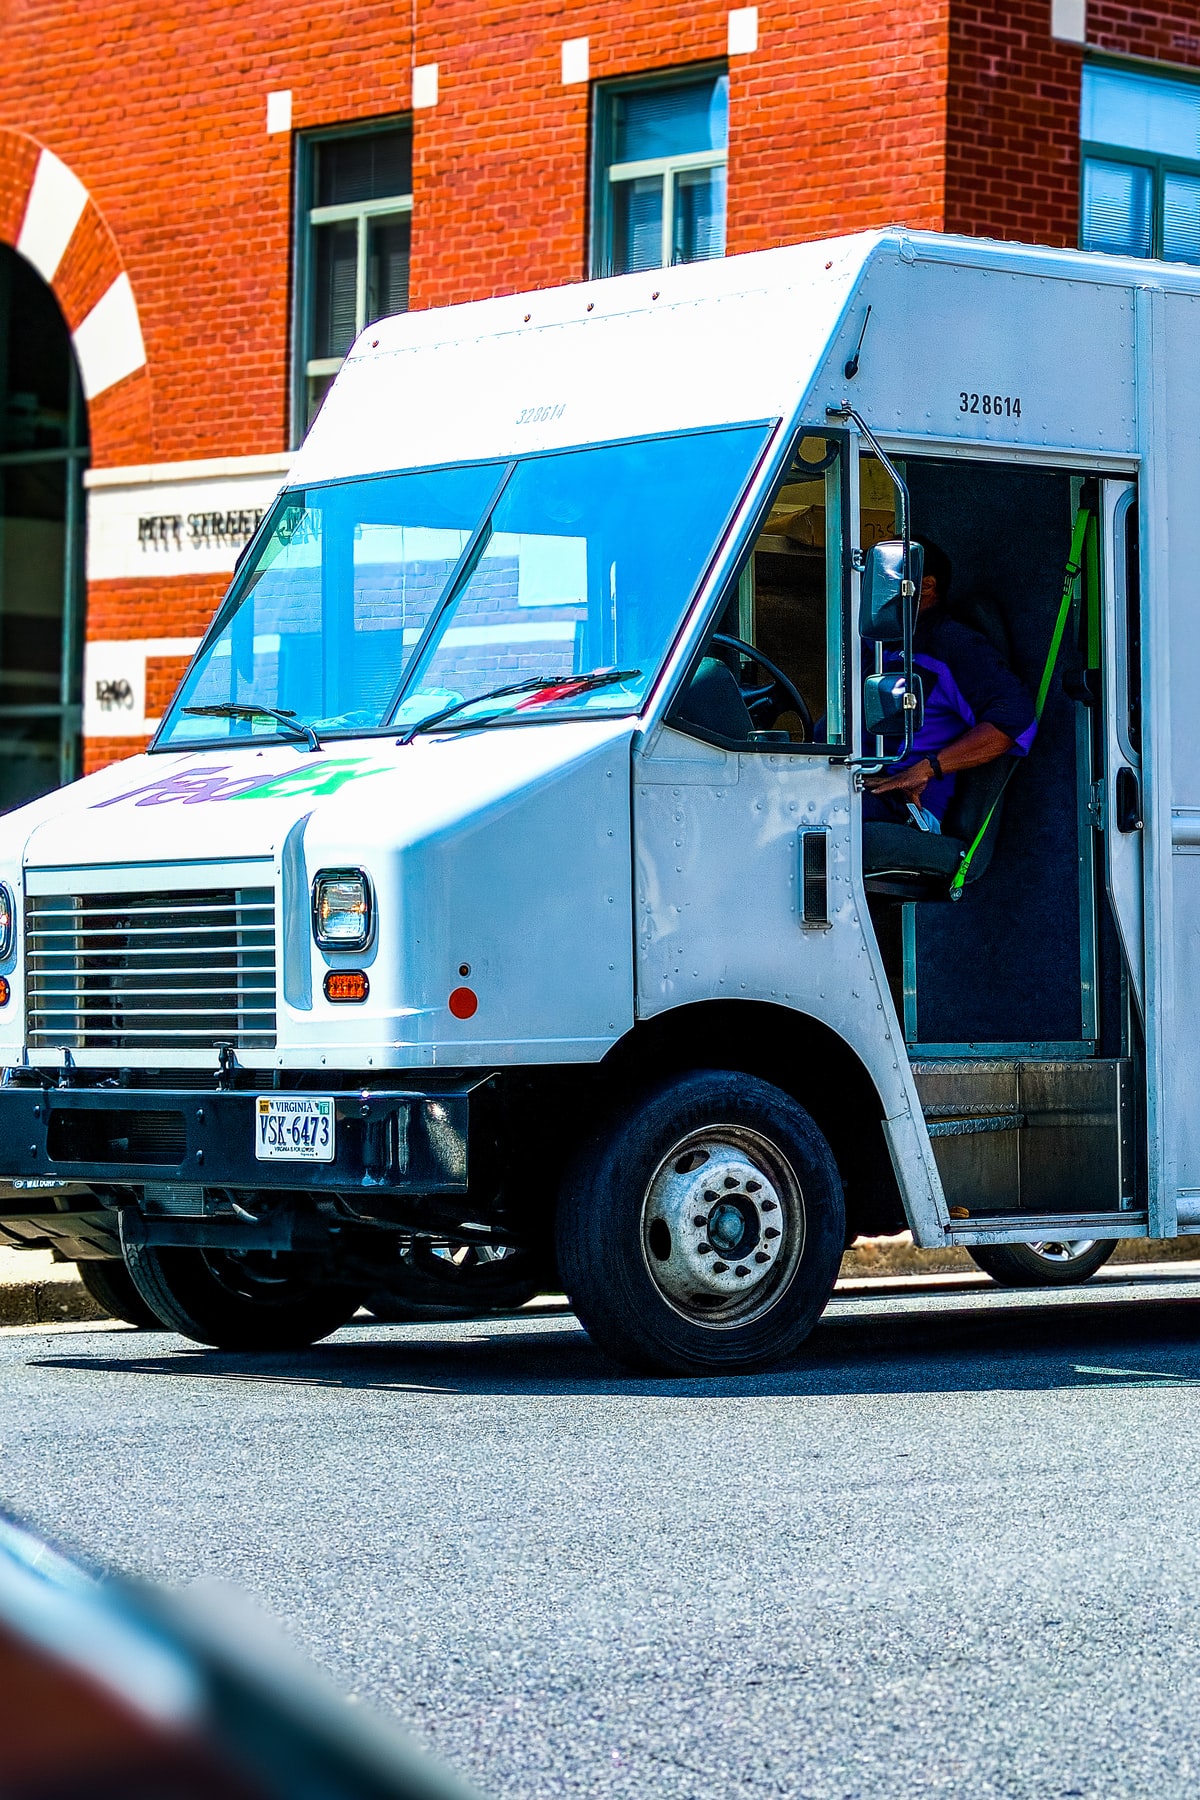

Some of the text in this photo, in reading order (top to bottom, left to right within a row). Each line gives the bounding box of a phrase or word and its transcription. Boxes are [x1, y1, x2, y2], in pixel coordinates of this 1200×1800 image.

[516, 403, 567, 425] 328614
[959, 392, 1022, 418] 328614
[187, 508, 264, 538] STREET
[86, 757, 398, 809] FedEx
[276, 1102, 313, 1112] VIRGINIA
[259, 1115, 330, 1147] VSK-6473
